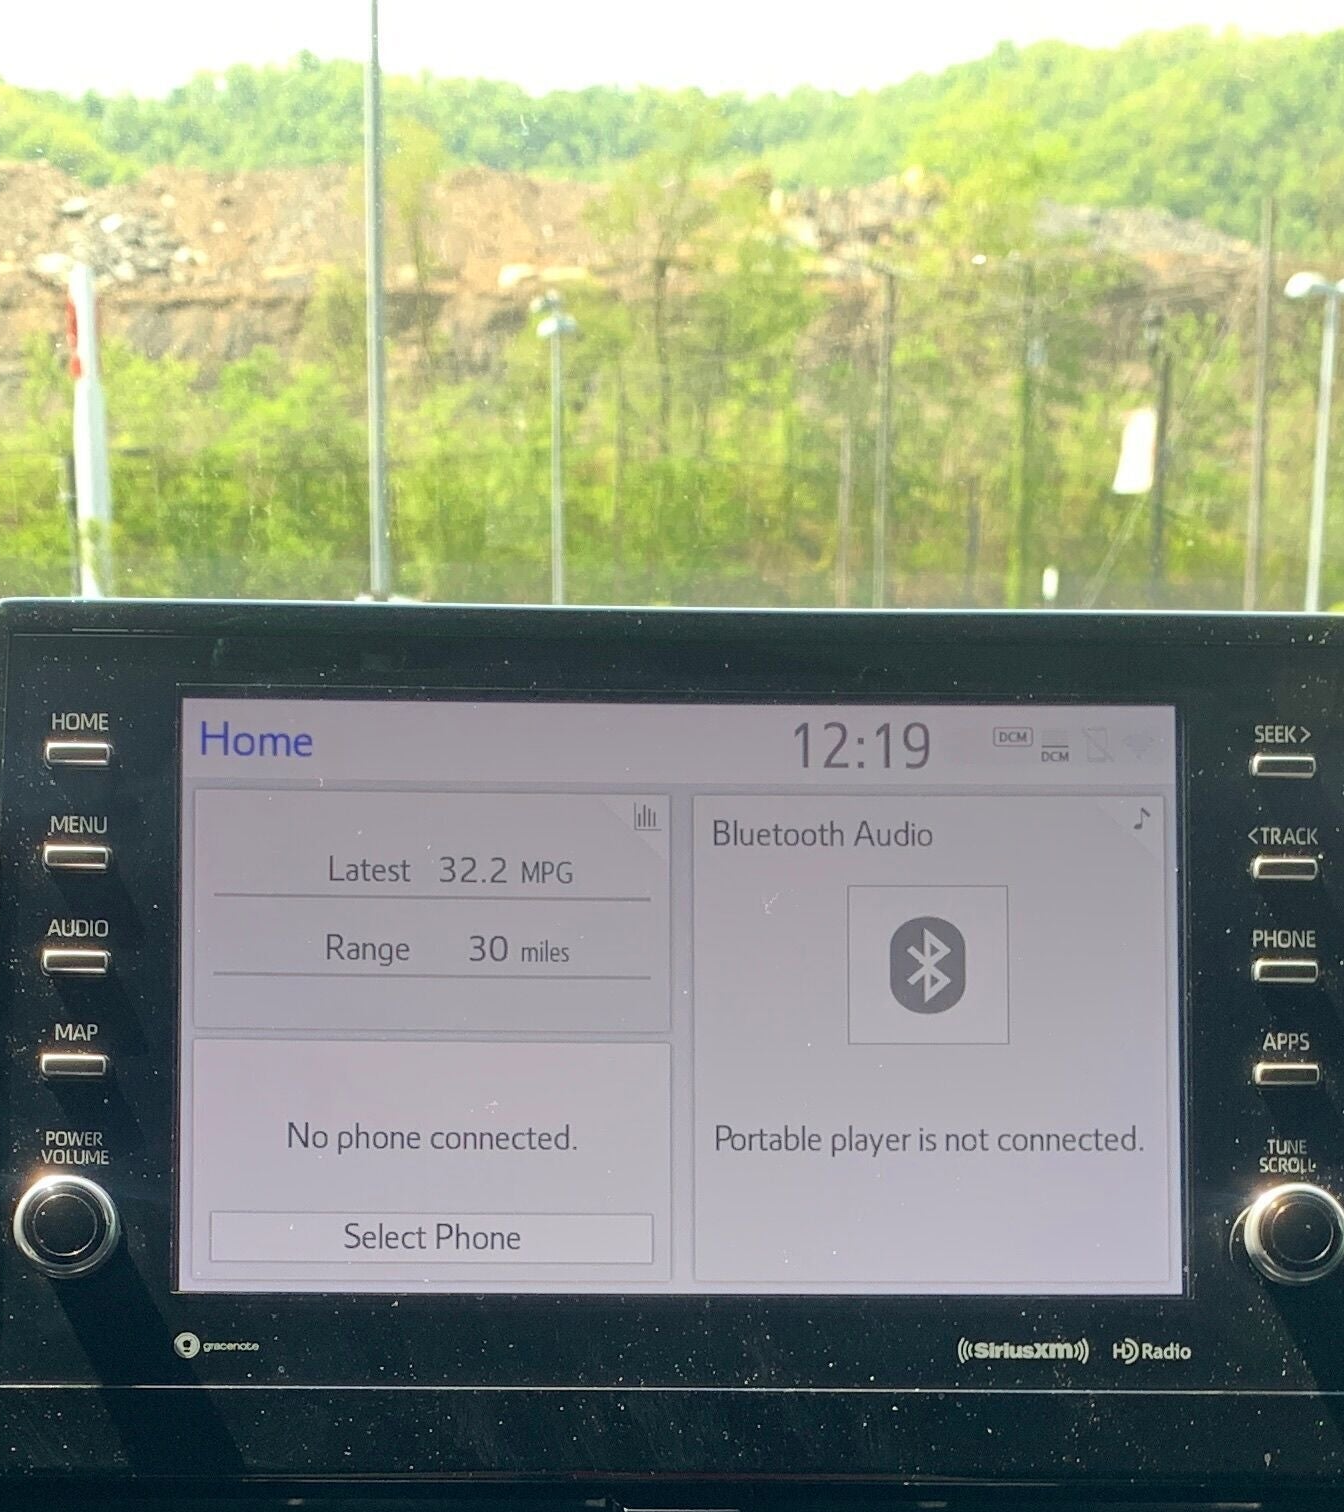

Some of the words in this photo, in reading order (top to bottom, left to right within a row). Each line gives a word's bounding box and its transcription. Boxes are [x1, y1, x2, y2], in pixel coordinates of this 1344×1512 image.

[51, 712, 109, 731] HOME
[199, 720, 314, 758] Home
[793, 721, 931, 770] 12:19
[999, 731, 1028, 745] DCM
[1041, 750, 1070, 764] DCM
[50, 815, 108, 834] MENU
[712, 819, 845, 848] Bluetooth
[853, 820, 934, 848] Audio
[327, 854, 412, 883] Latest
[438, 856, 509, 885] 32.2
[520, 860, 574, 885] MPG
[46, 919, 110, 938] AUDIO
[1252, 930, 1316, 949] PHONE
[325, 933, 411, 967] Range
[468, 934, 510, 963] 30
[520, 940, 570, 963] miles
[54, 1023, 99, 1042] MAP
[1262, 1032, 1310, 1051] APPS
[45, 1130, 104, 1147] POWER
[286, 1122, 329, 1151] No
[336, 1122, 422, 1155] phone
[429, 1124, 579, 1152] connected.
[715, 1125, 822, 1153] Portable
[831, 1125, 912, 1158] player
[919, 1126, 937, 1152] is
[944, 1128, 990, 1152] not
[997, 1125, 1145, 1153] connected.
[1266, 1138, 1308, 1154] TUNE
[41, 1149, 110, 1165] VOLUME
[1258, 1157, 1316, 1174] SCROLL
[343, 1222, 427, 1251] Select
[435, 1223, 522, 1251] Phone
[1141, 1341, 1193, 1361] Radio
